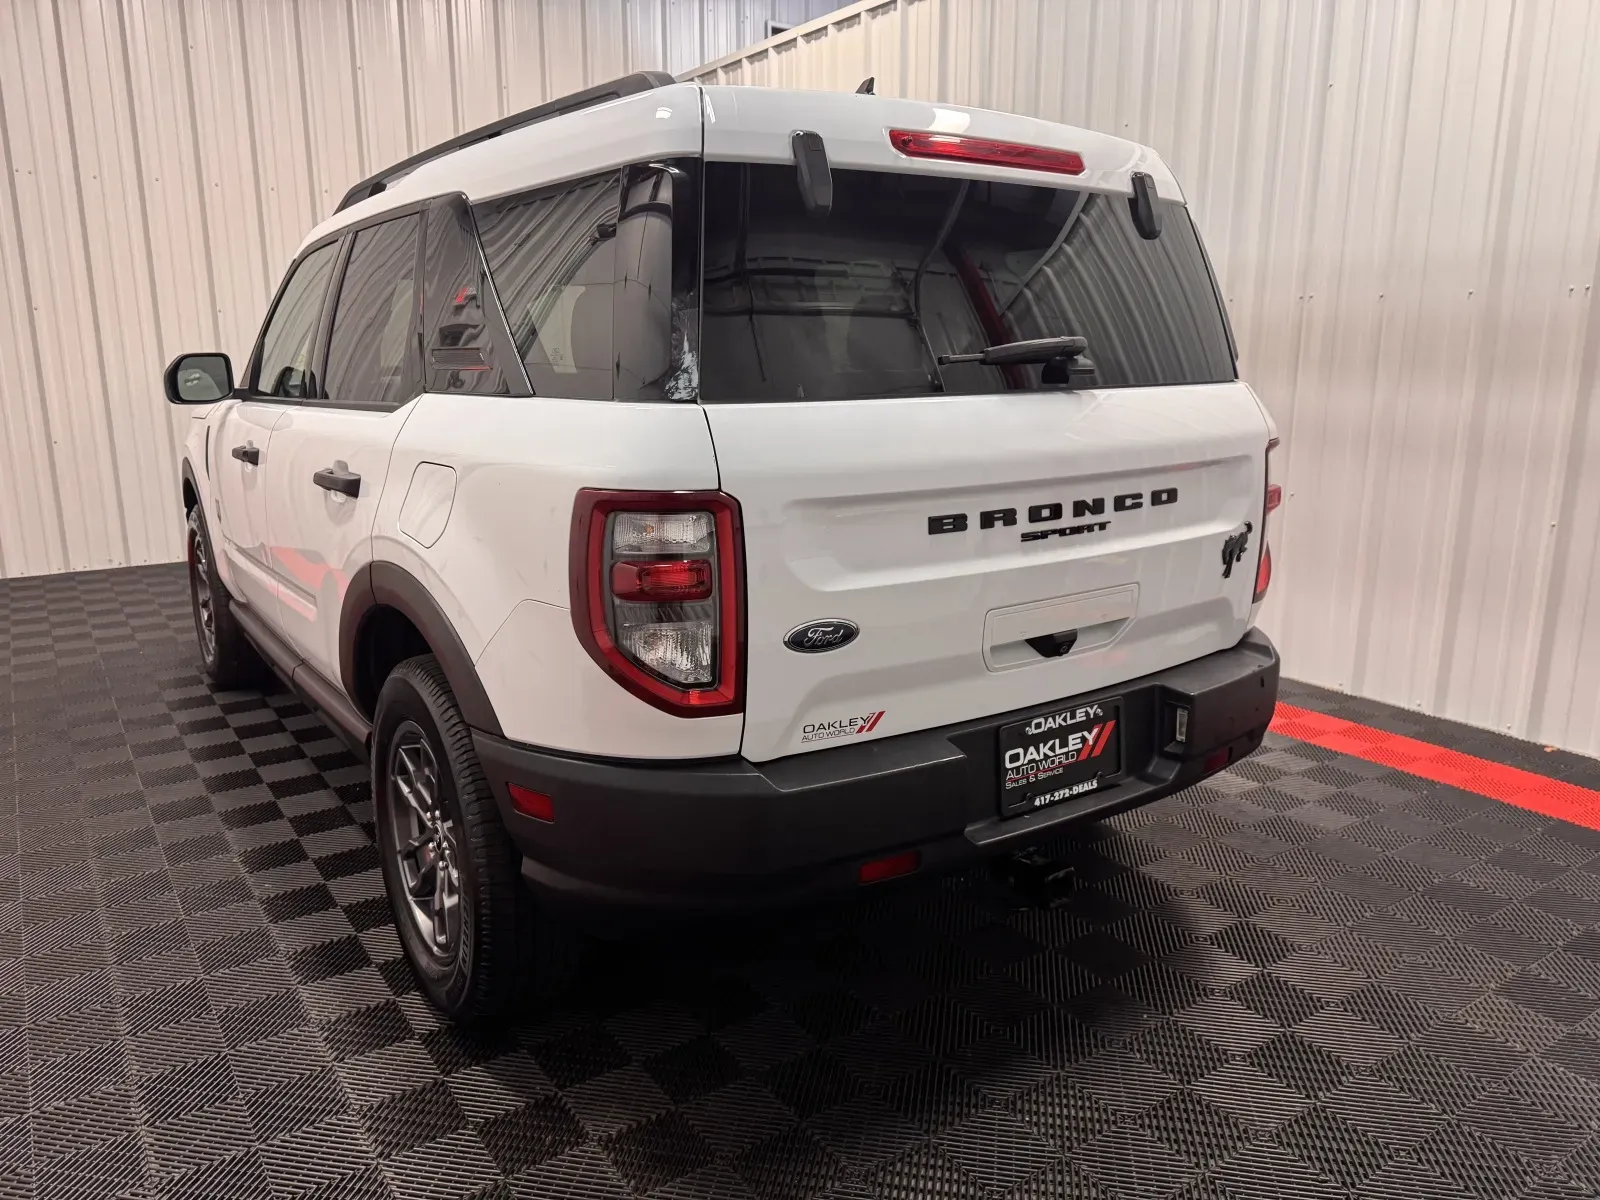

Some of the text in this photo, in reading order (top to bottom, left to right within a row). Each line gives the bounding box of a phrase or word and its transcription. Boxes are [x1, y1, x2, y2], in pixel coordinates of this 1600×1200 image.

[927, 487, 1178, 535] BRONCO
[1020, 520, 1112, 543] SPORT
[803, 626, 844, 648] Ford
[803, 715, 871, 734] OAKLEY
[1031, 704, 1099, 734] OAKLEY
[801, 727, 856, 742] AUTO WORLD
[1005, 727, 1100, 769] OAKLEY
[1006, 751, 1077, 781] AUTO WORLD
[1029, 774, 1036, 783] &
